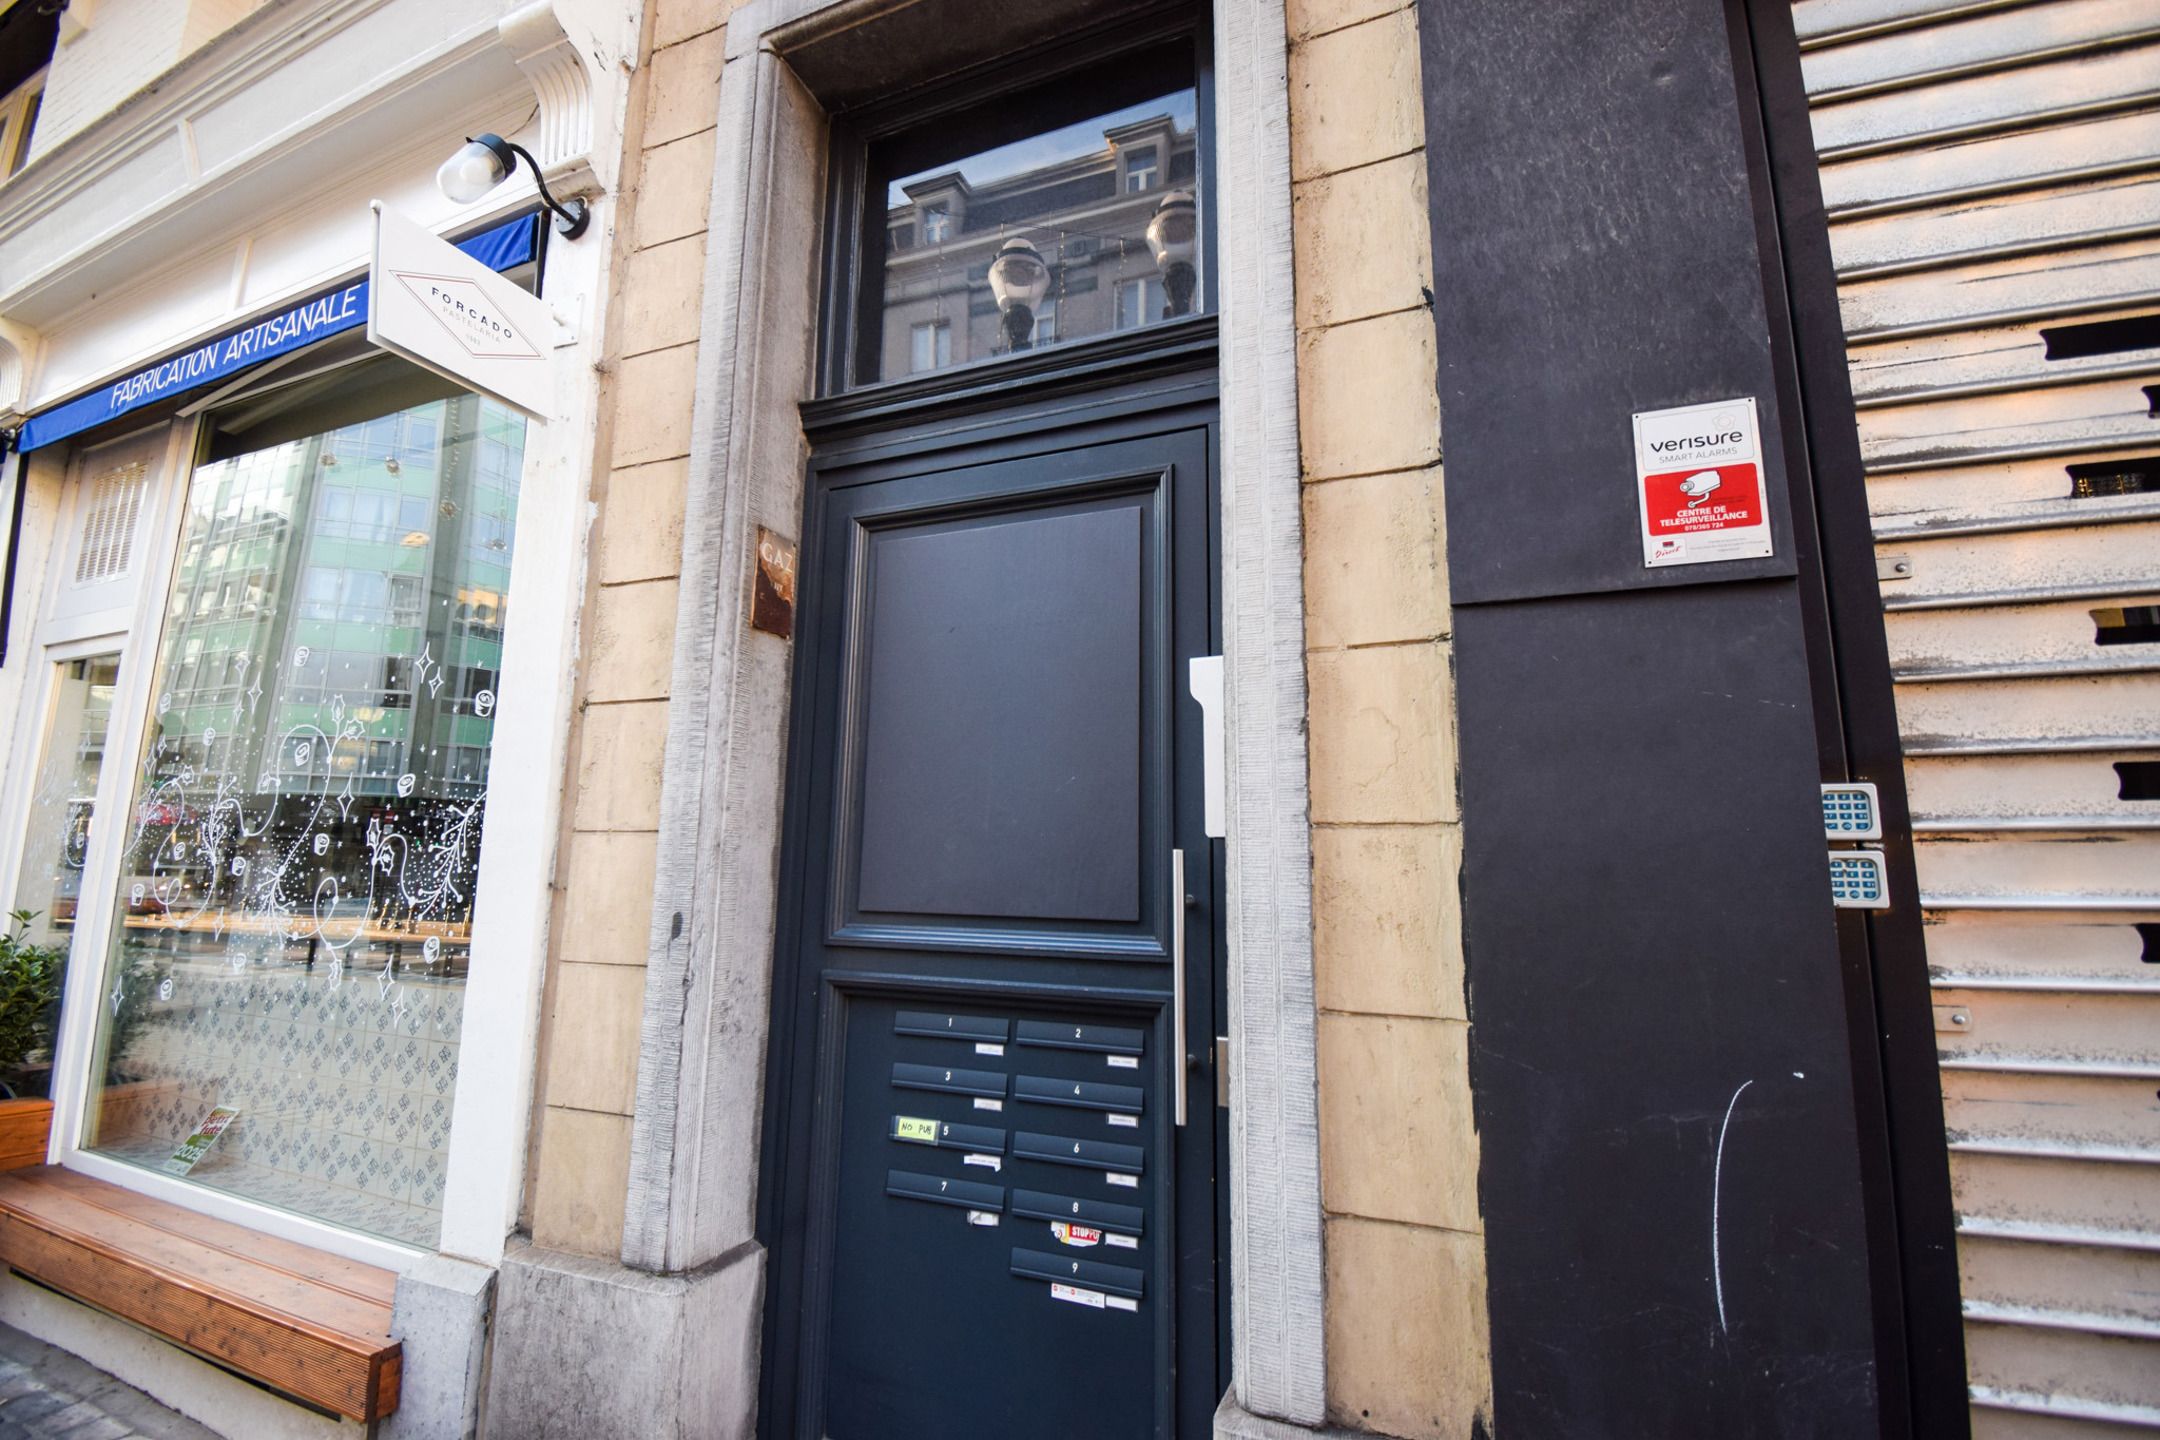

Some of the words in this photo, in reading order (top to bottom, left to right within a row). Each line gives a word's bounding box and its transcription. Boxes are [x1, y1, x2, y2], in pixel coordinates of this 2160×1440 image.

[431, 287, 513, 339] FORCADO
[110, 343, 219, 409] FABRICATION
[222, 284, 362, 365] ARTISANALE
[1650, 431, 1743, 453] verisure
[1659, 453, 1693, 464] SMART
[1695, 447, 1738, 460] ALARMS
[1676, 506, 1711, 518] CENTRE
[1713, 505, 1727, 514] DE
[1659, 511, 1748, 527] TELESURVEILLANCE
[760, 542, 793, 574] GAZ
[948, 1017, 953, 1028] 1
[1075, 1028, 1081, 1039] 2
[945, 1071, 951, 1081] 3
[1074, 1085, 1080, 1095] 4
[943, 1126, 949, 1136] 5
[175, 1144, 206, 1160] 2025
[1073, 1142, 1080, 1153] 6
[941, 1181, 947, 1191] 7
[1072, 1202, 1079, 1213] 8
[1071, 1226, 1089, 1238] STOP
[1072, 1262, 1079, 1274] 9
